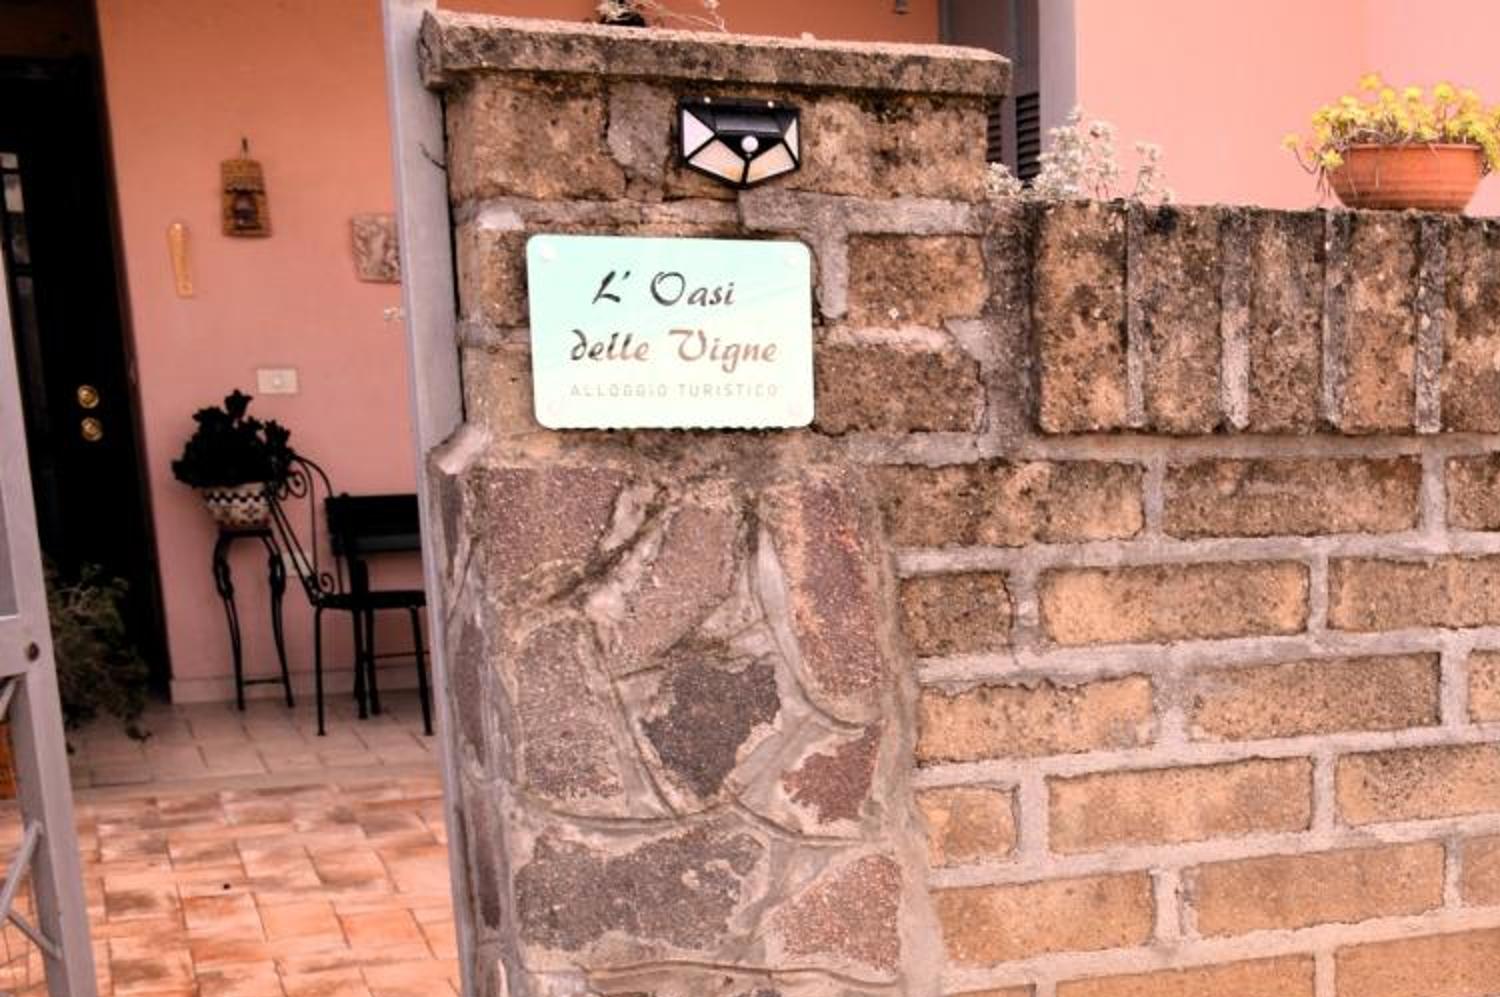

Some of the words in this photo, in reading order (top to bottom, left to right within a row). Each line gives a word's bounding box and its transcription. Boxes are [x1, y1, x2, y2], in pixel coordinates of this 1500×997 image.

[592, 270, 631, 304] L'
[650, 271, 736, 306] Oasi
[570, 329, 650, 361] delle
[668, 329, 778, 373] Vigne
[570, 383, 667, 397] ALLOGGIO
[678, 383, 777, 397] TURISTICO
